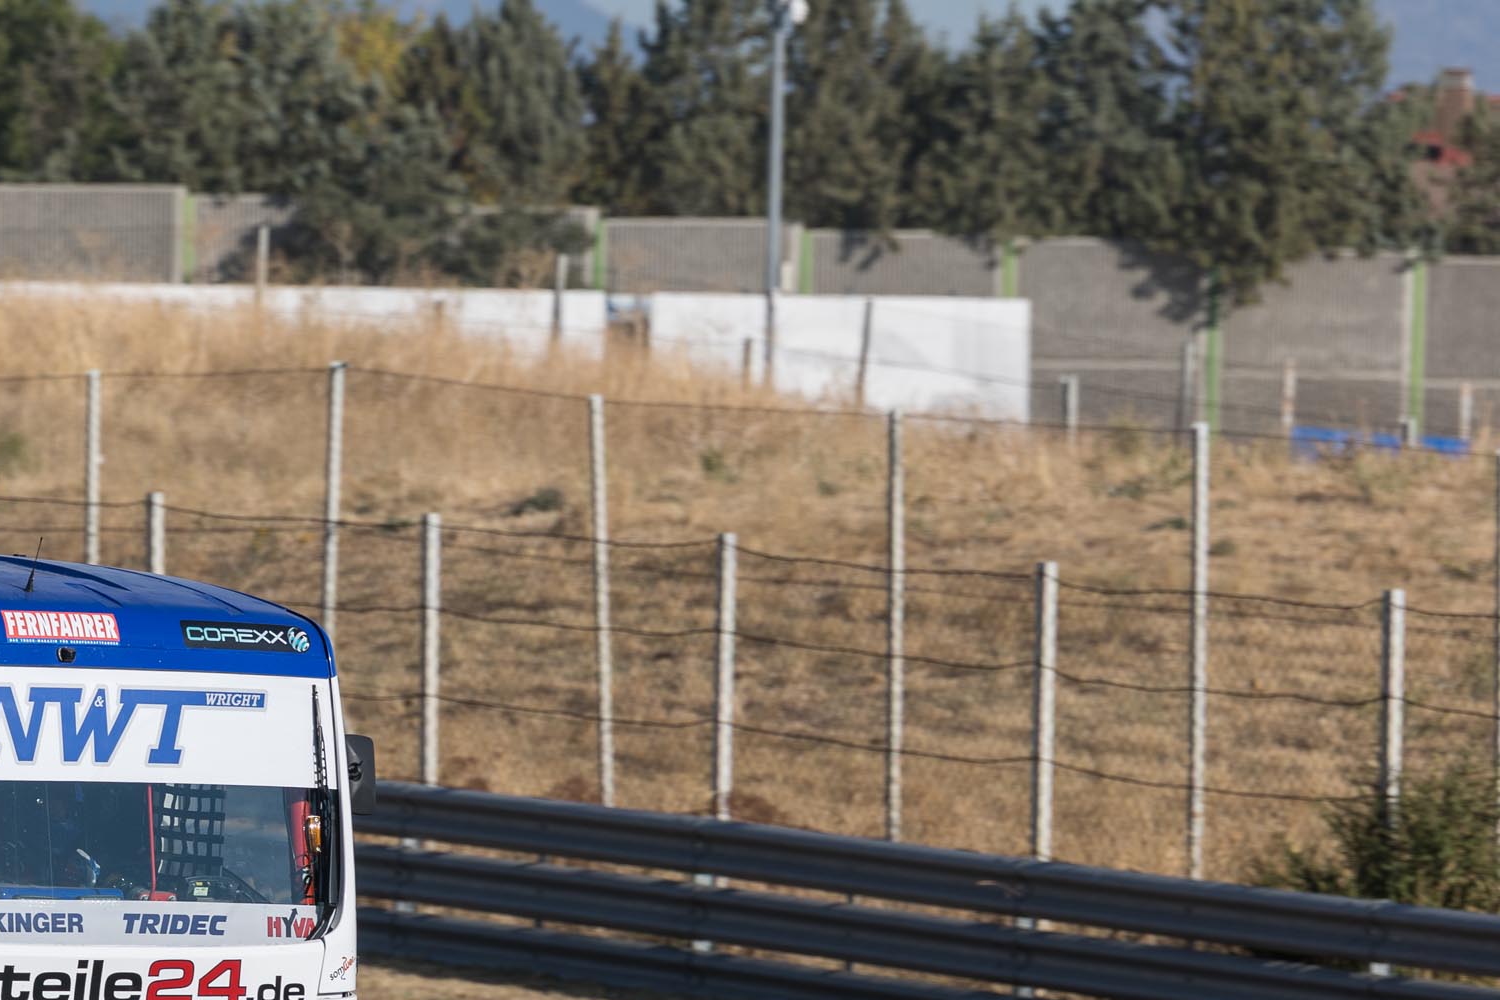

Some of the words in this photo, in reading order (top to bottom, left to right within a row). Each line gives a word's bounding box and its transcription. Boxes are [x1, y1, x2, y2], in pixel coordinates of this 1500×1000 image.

[4, 611, 118, 639] FERNFAHRER
[186, 626, 288, 644] COREXX
[206, 692, 261, 707] WRIGHT
[123, 913, 228, 936] TRIDEC
